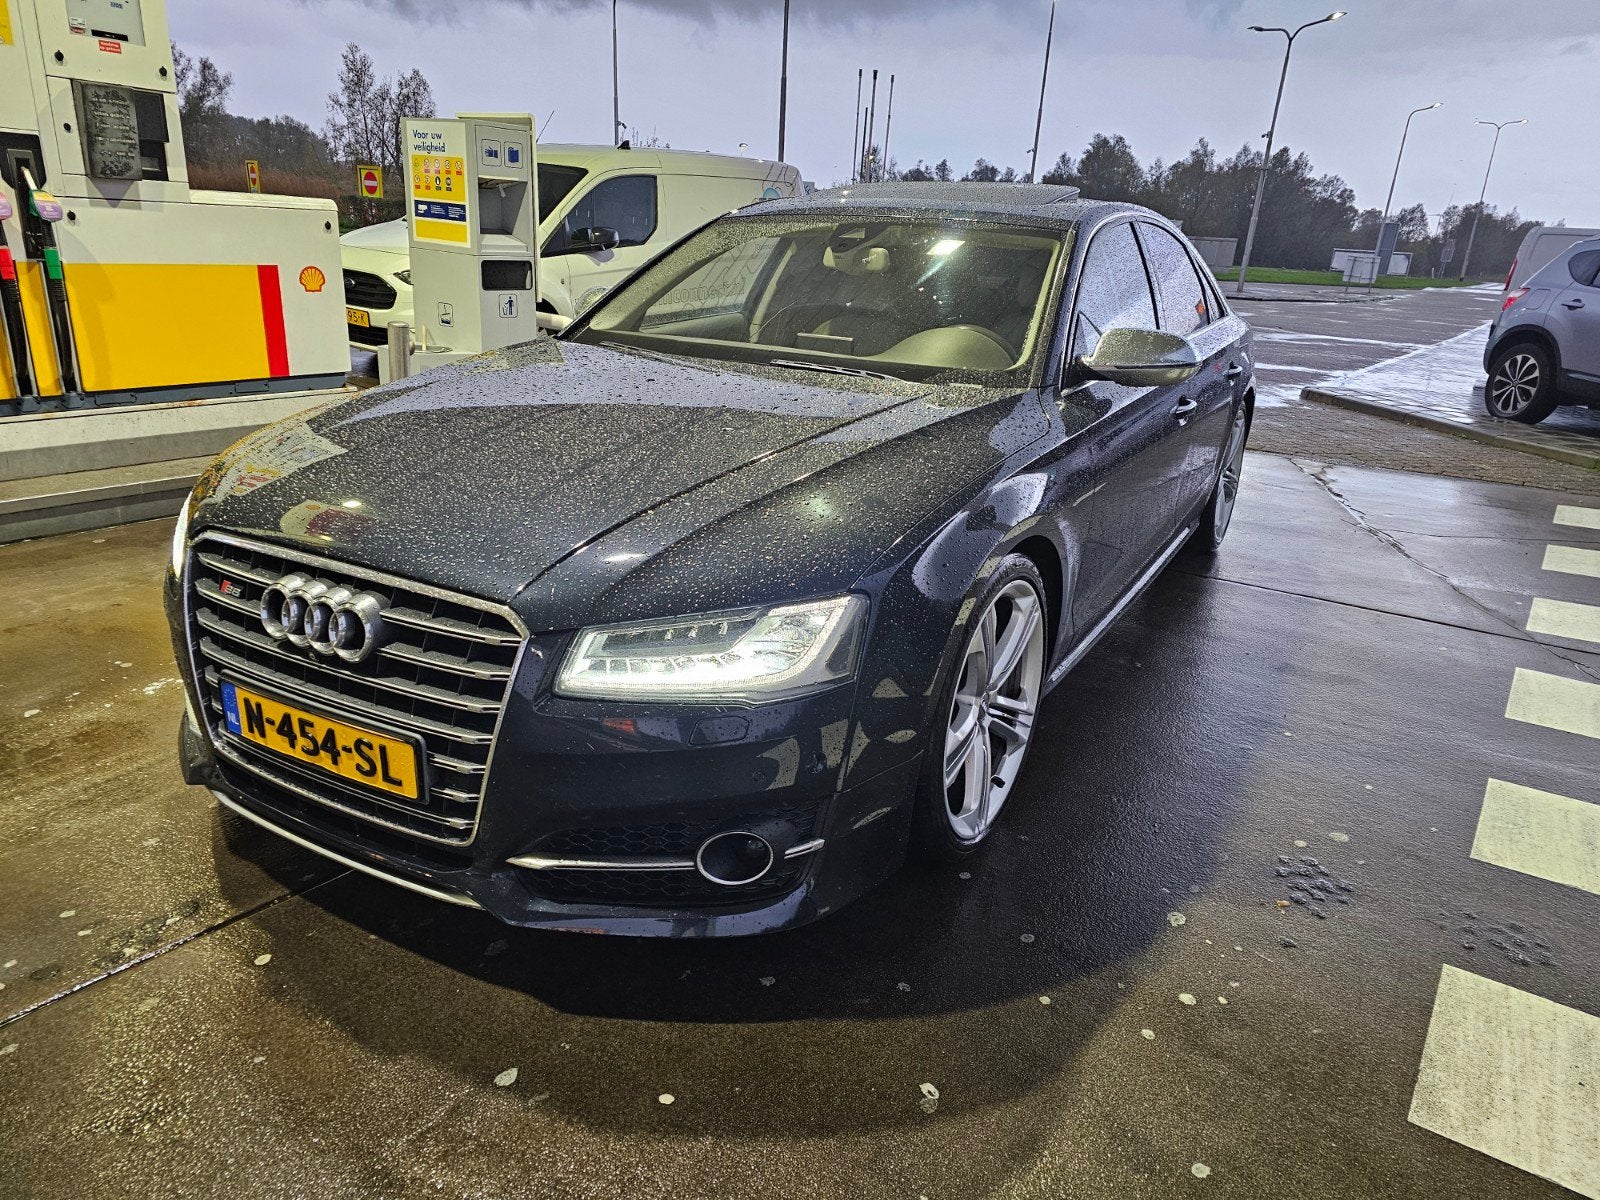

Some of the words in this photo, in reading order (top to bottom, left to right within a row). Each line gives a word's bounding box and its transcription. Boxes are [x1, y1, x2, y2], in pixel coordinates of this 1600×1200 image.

[412, 129, 428, 139] Voor
[430, 132, 443, 140] uw
[413, 141, 446, 154] veiligheid
[227, 711, 240, 725] NL
[243, 696, 403, 787] N-454-SL
